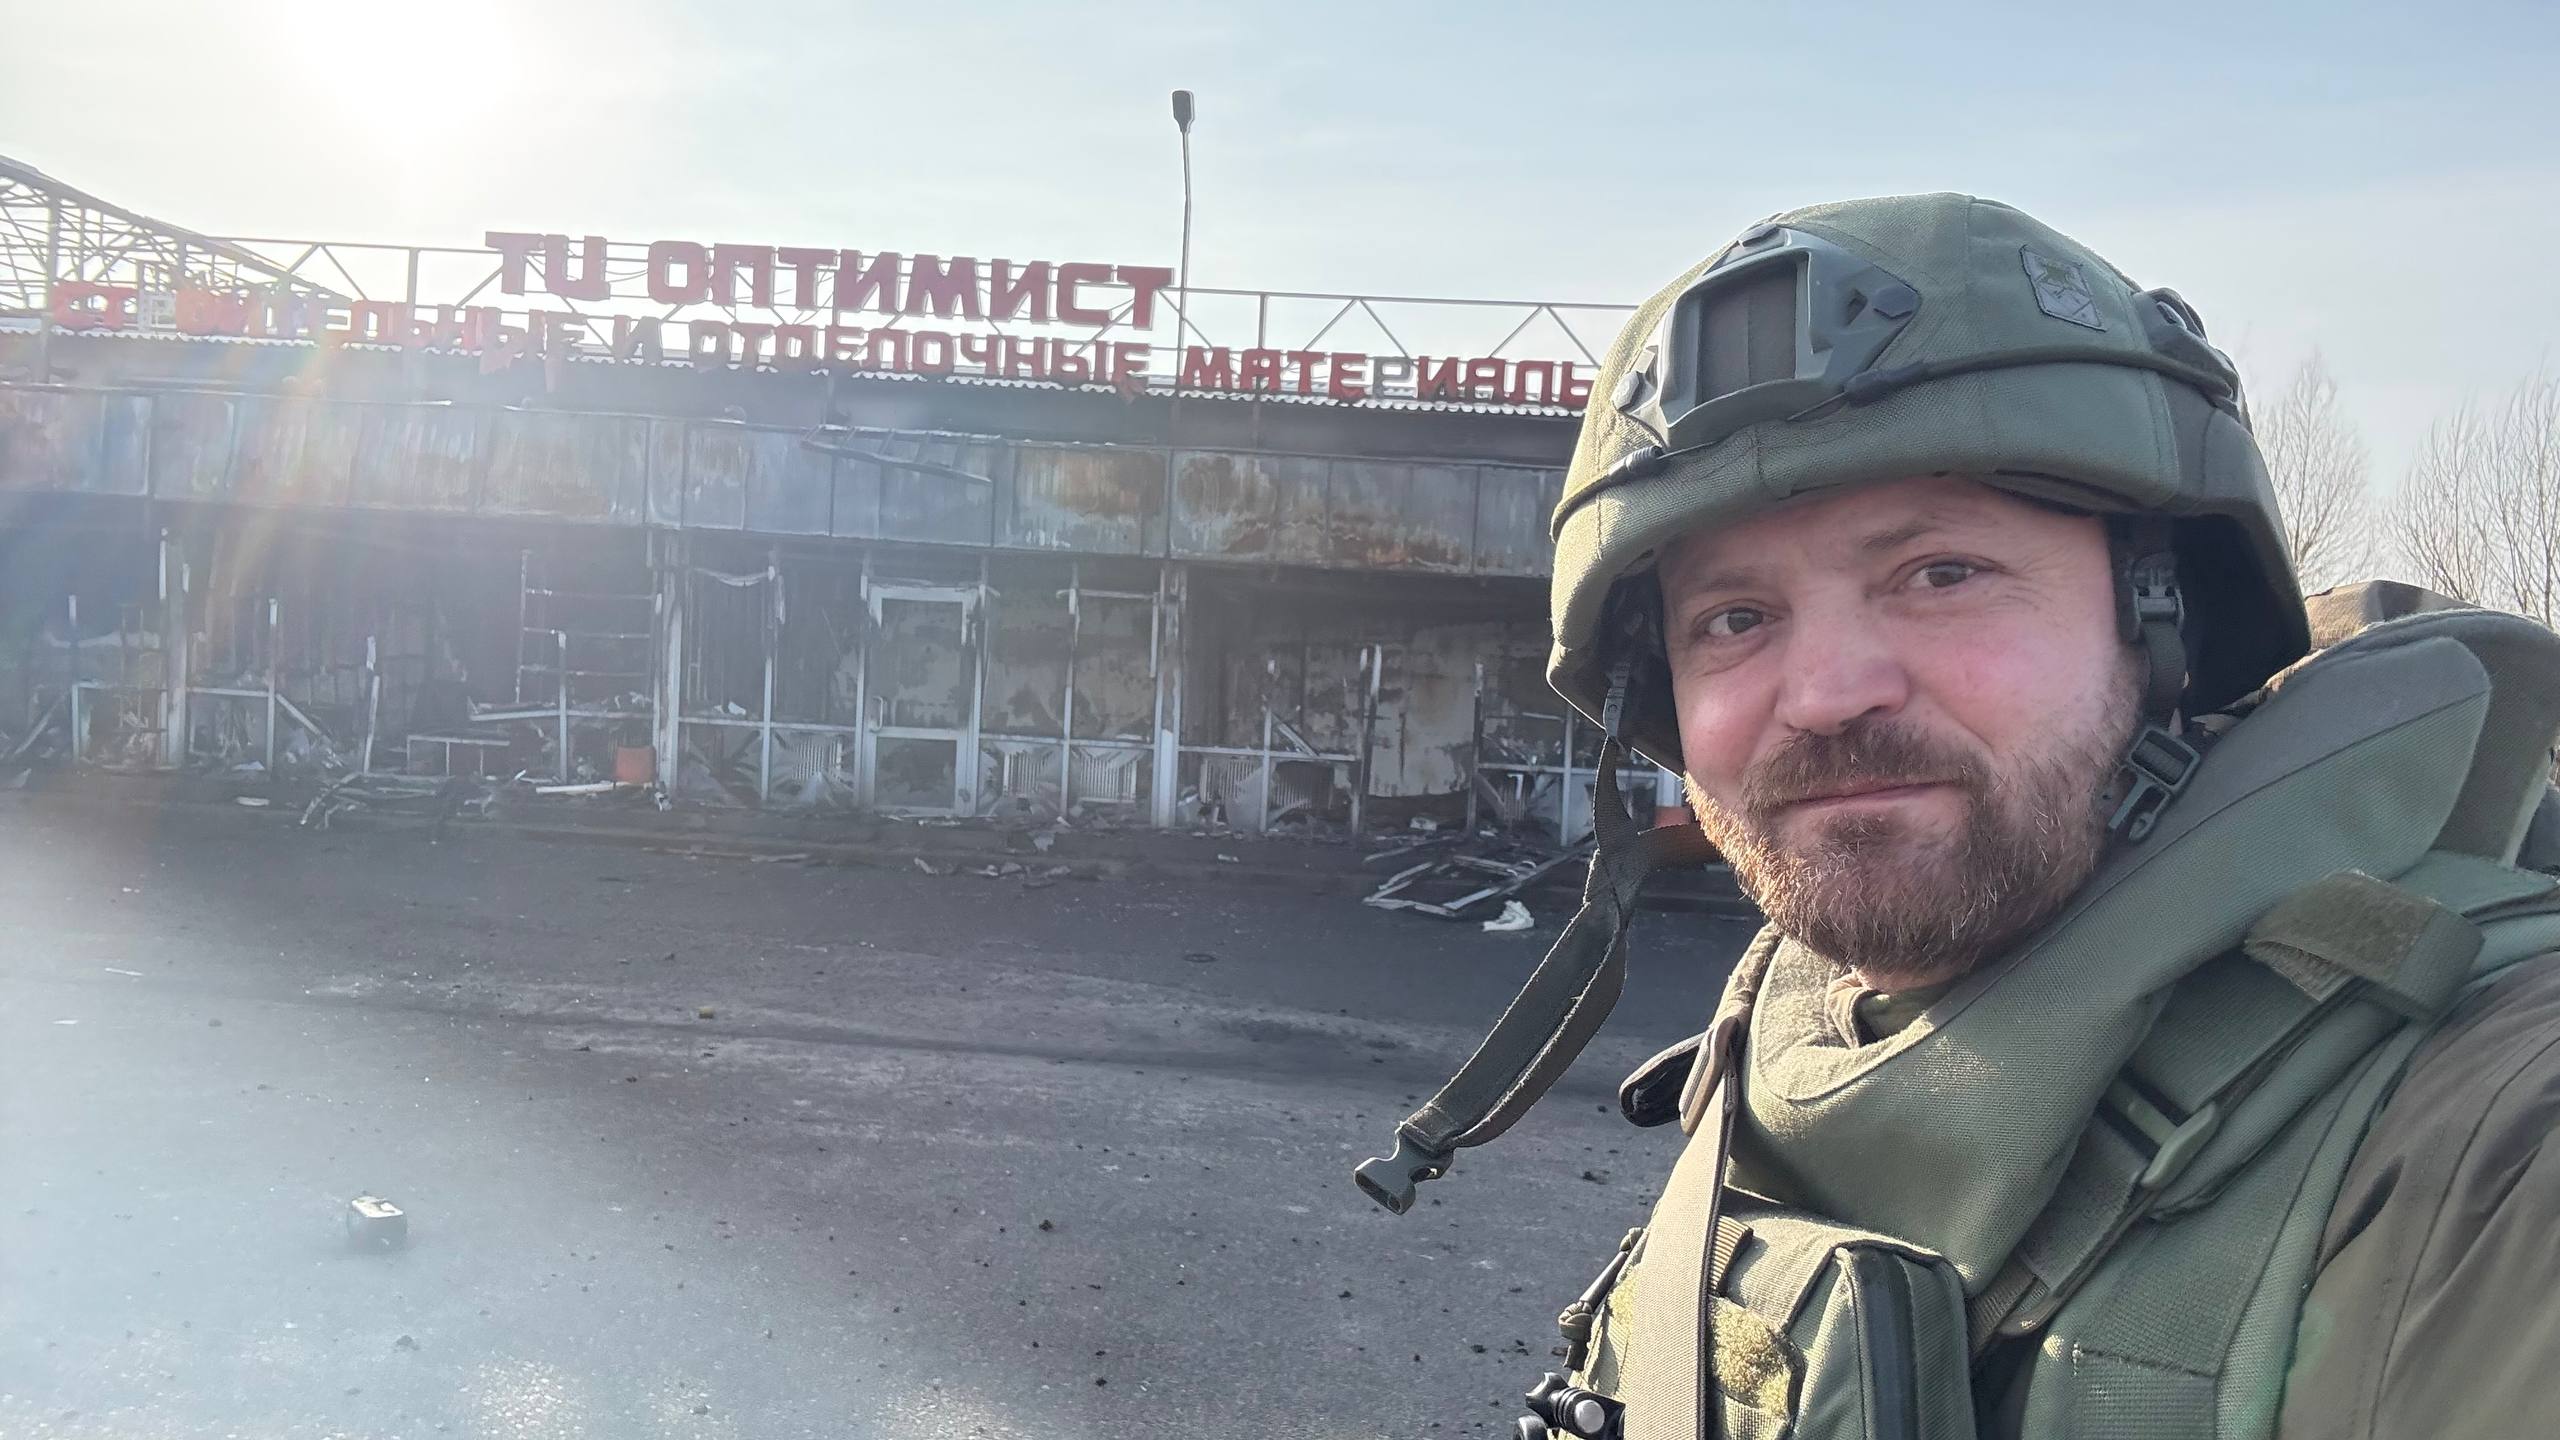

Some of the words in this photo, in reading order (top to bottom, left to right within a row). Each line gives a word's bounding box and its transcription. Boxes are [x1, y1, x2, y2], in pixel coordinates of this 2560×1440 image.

[485, 231, 611, 301] ТЦ
[647, 240, 1175, 330] ОПТИМИСТ
[611, 315, 663, 363] И
[688, 319, 1151, 390] ОТДЕЛОЧНЫЕ
